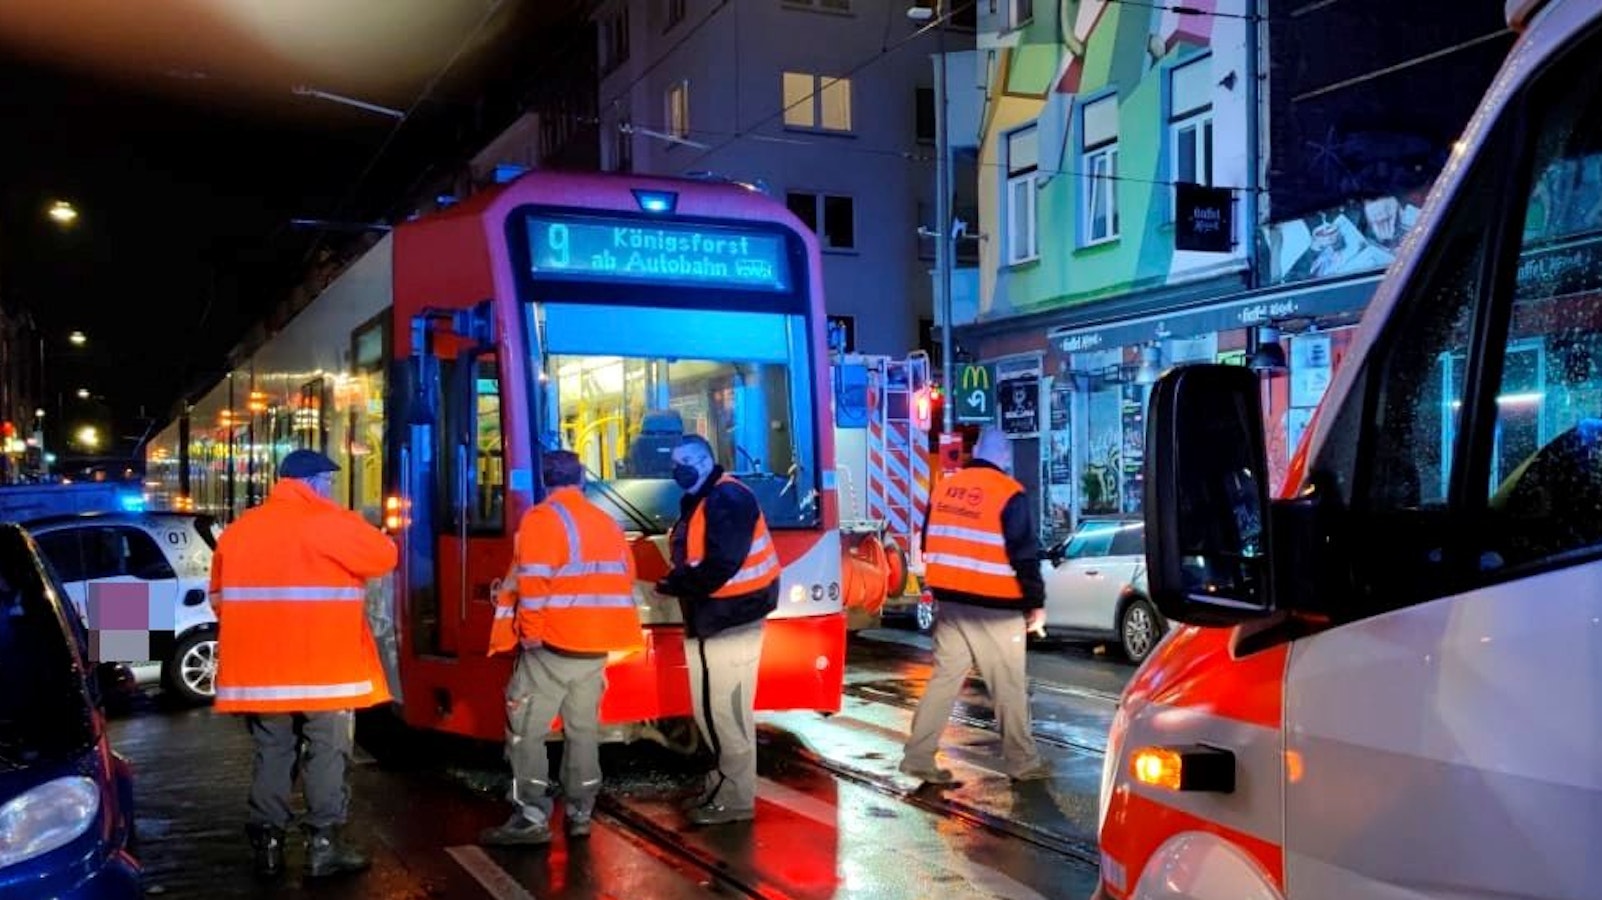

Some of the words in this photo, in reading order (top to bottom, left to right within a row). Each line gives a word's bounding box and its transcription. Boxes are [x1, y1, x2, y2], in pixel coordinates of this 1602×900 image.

[548, 223, 569, 268] 9
[613, 227, 749, 255] Königsforst
[591, 248, 617, 271] ab
[627, 251, 728, 277] Autobahn
[168, 532, 188, 544] 01
